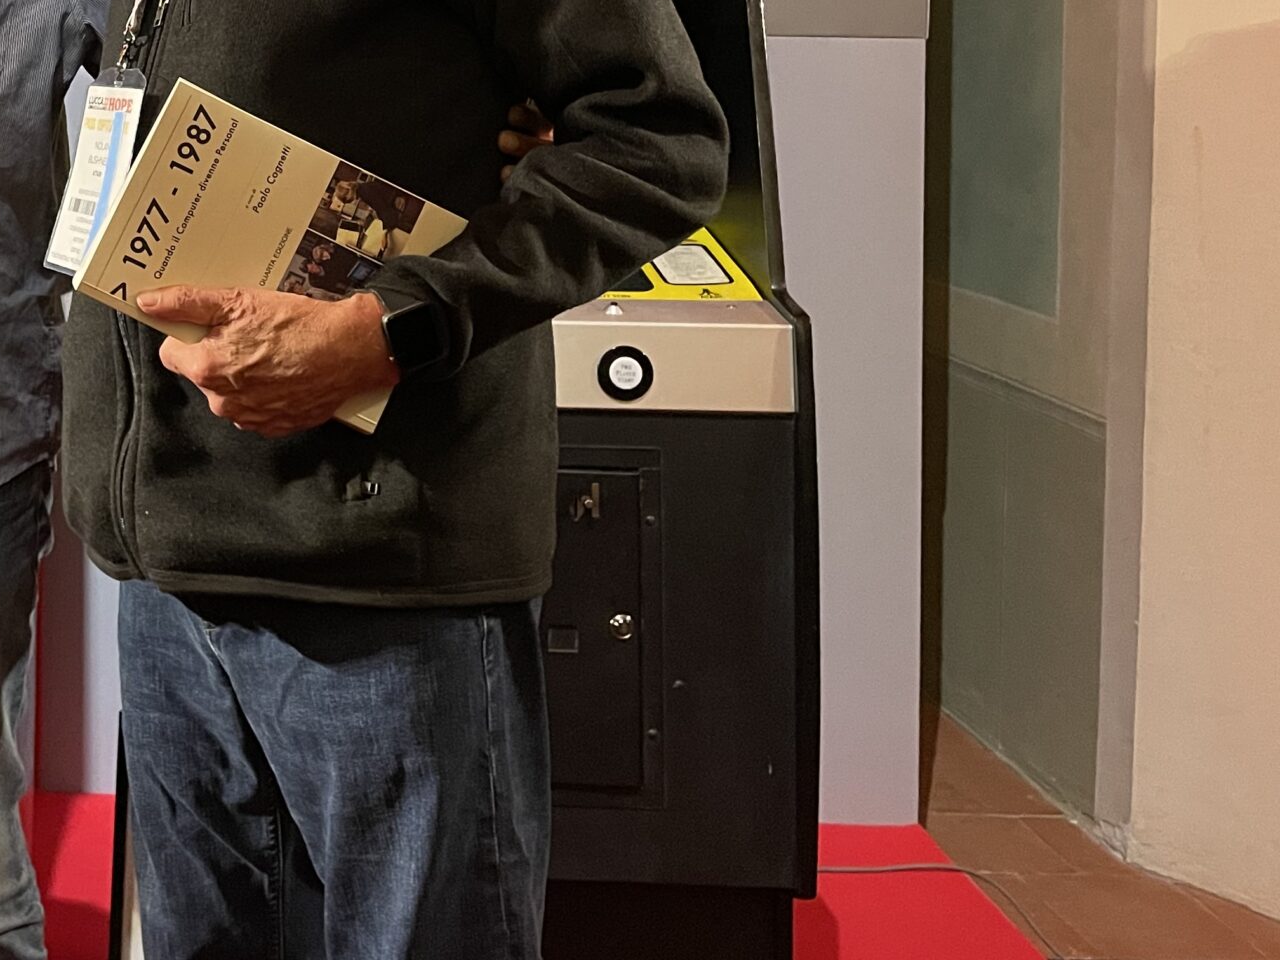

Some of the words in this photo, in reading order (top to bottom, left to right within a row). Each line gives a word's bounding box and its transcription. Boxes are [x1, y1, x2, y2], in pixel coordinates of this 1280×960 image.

[107, 97, 134, 113] HOPE
[122, 197, 169, 269] 1977
[169, 104, 216, 175] 1987
[153, 244, 176, 280] Quando
[171, 235, 181, 244] il
[176, 194, 202, 235] Computer
[198, 157, 219, 192] divenne
[215, 117, 240, 155] Personal
[252, 187, 271, 214] Paolo
[266, 145, 292, 185] Cognetti
[259, 259, 277, 287] QUARTA
[274, 227, 293, 259] EDIZIONE
